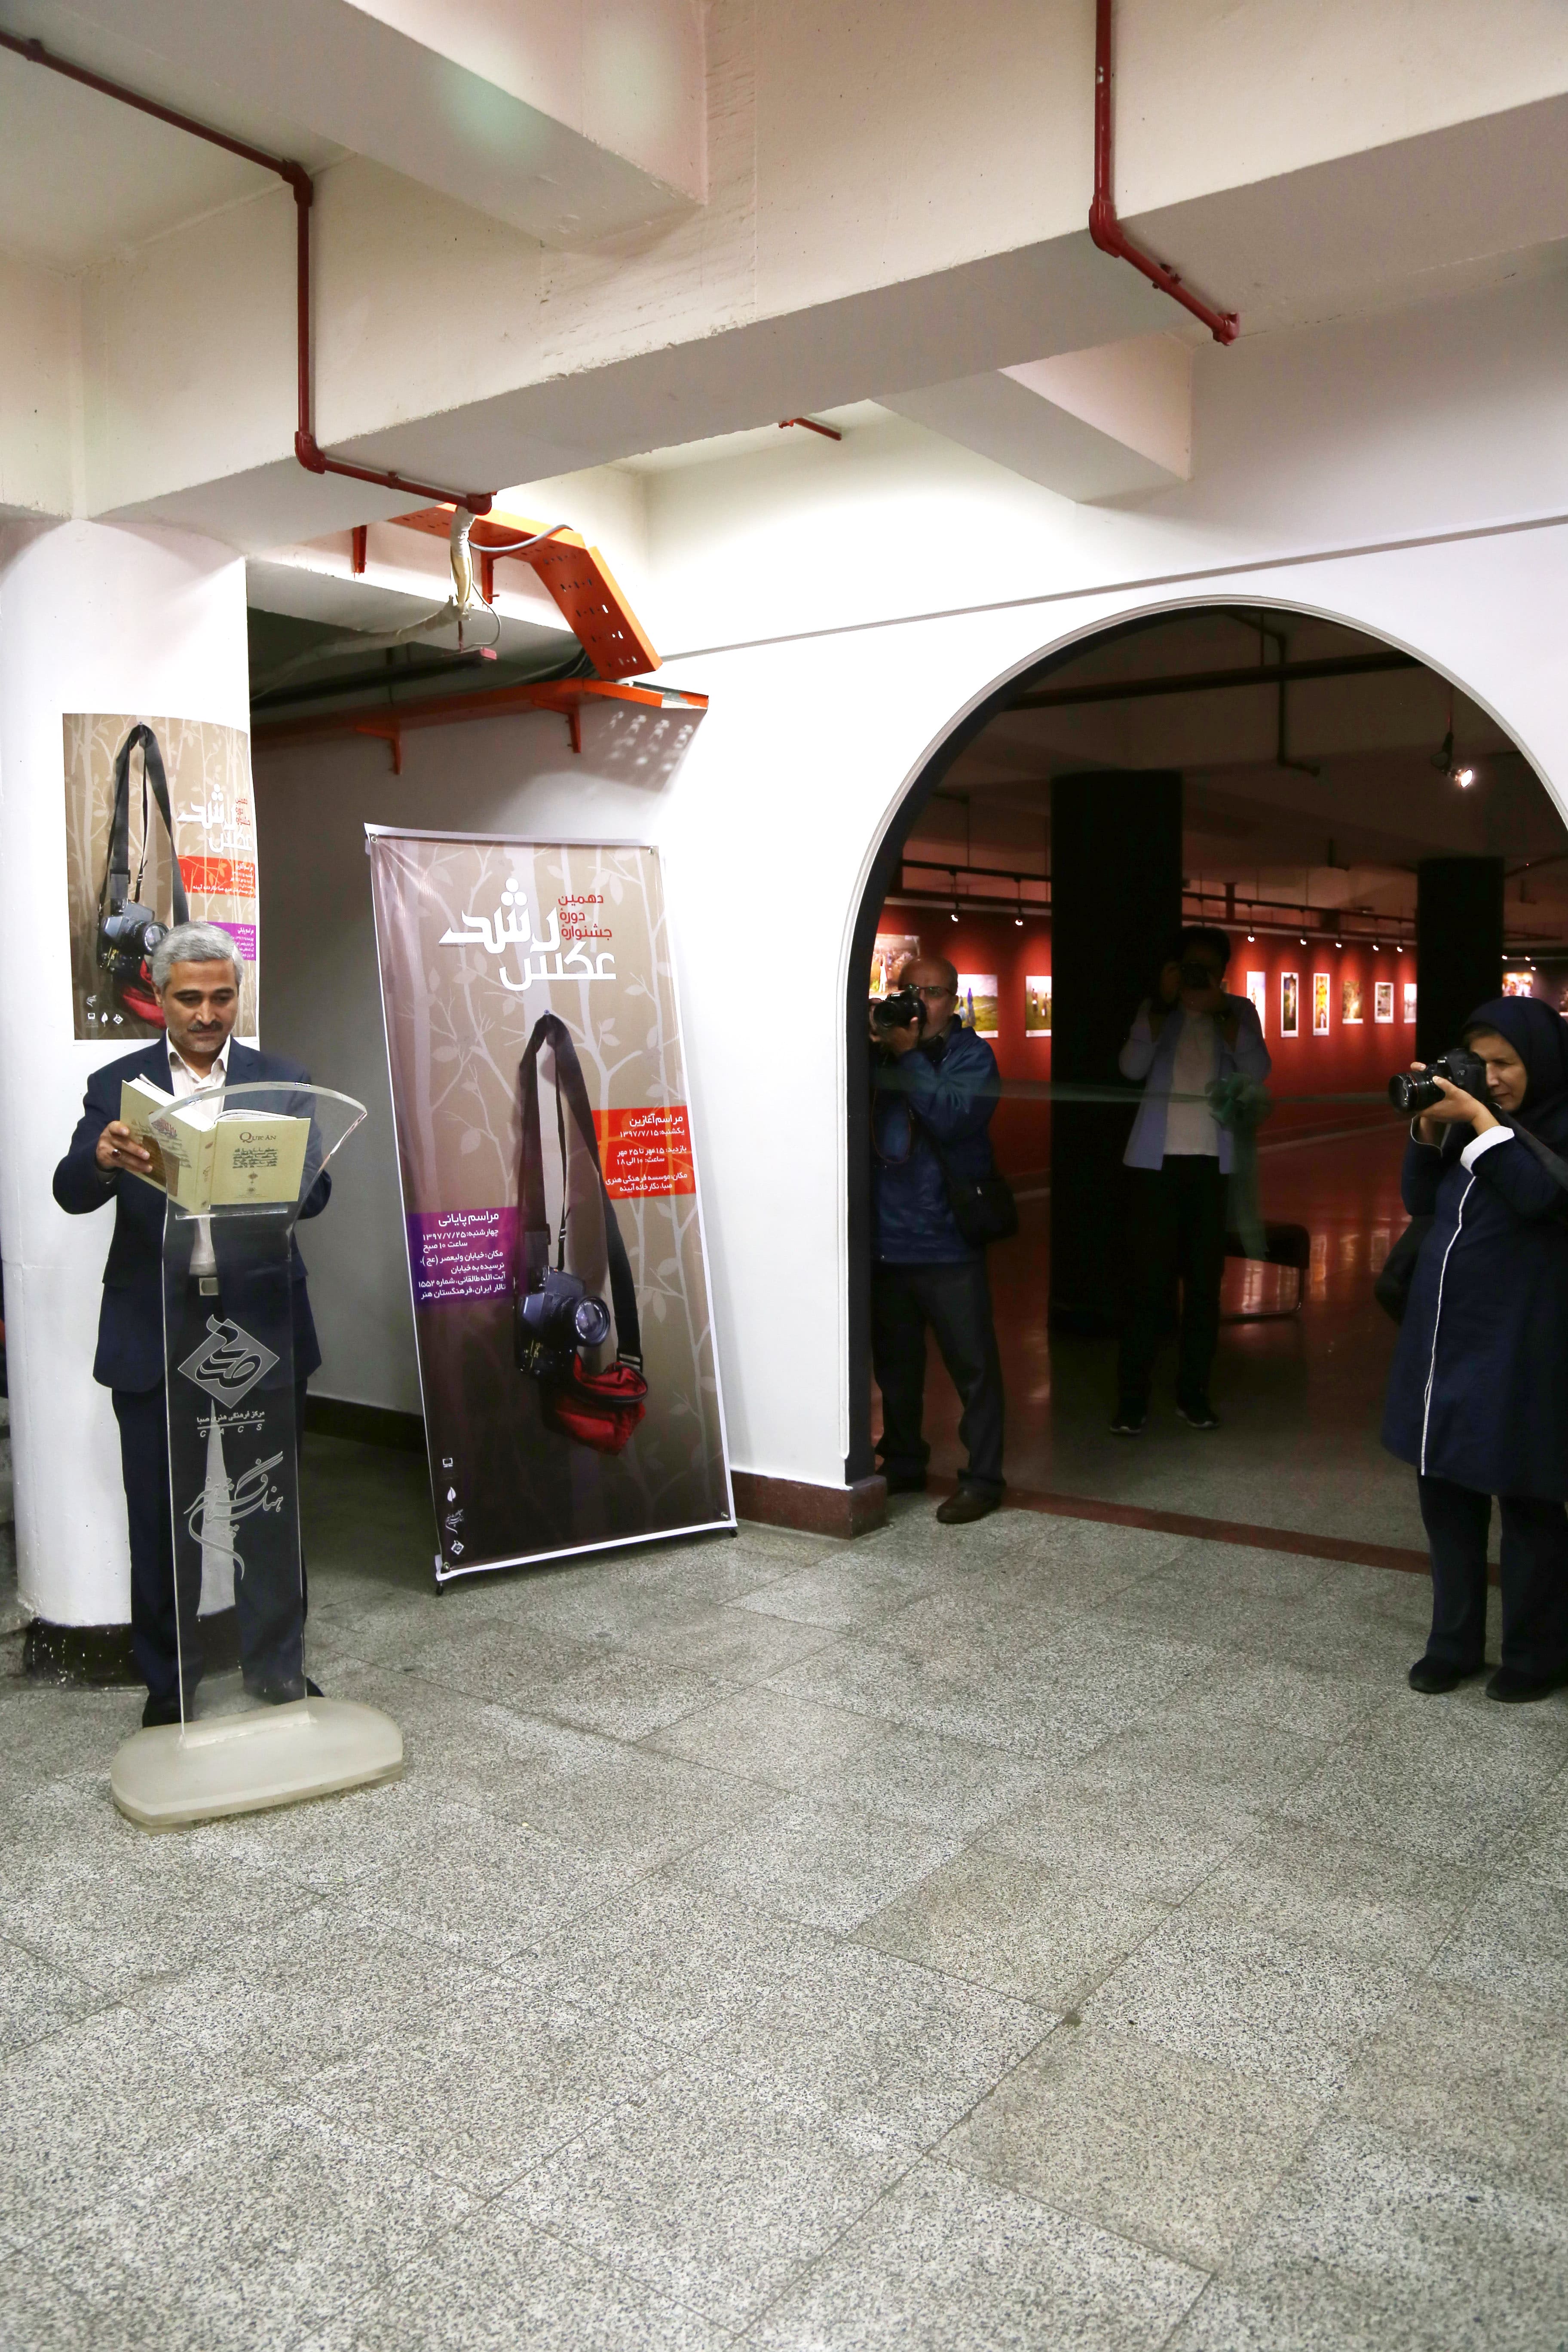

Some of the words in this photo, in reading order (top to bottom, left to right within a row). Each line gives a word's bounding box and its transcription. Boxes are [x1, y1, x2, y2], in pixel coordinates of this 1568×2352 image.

[177, 784, 236, 830] رشد
[558, 894, 603, 906] دهمین
[438, 877, 561, 954] رشد
[499, 941, 617, 991] عکس
[629, 1113, 655, 1127] آغازین
[655, 1114, 683, 1125] مراسم
[626, 1157, 635, 1166] الی
[623, 1174, 646, 1184] فرهنگی
[438, 1213, 467, 1227] پایانی
[468, 1210, 499, 1225] مراسم
[423, 1243, 438, 1253] صبح
[440, 1253, 463, 1264] ولیعصر
[464, 1251, 484, 1262] خیابان
[451, 1264, 472, 1274] خیابان
[480, 1262, 505, 1271] نرسیده
[493, 1271, 506, 1280] آیت
[436, 1277, 455, 1287] شماره
[493, 1283, 506, 1292] تالار
[434, 1286, 472, 1298] فرهنگستان
[228, 1411, 250, 1421] فرهنگی
[251, 1410, 265, 1418] مرکز
